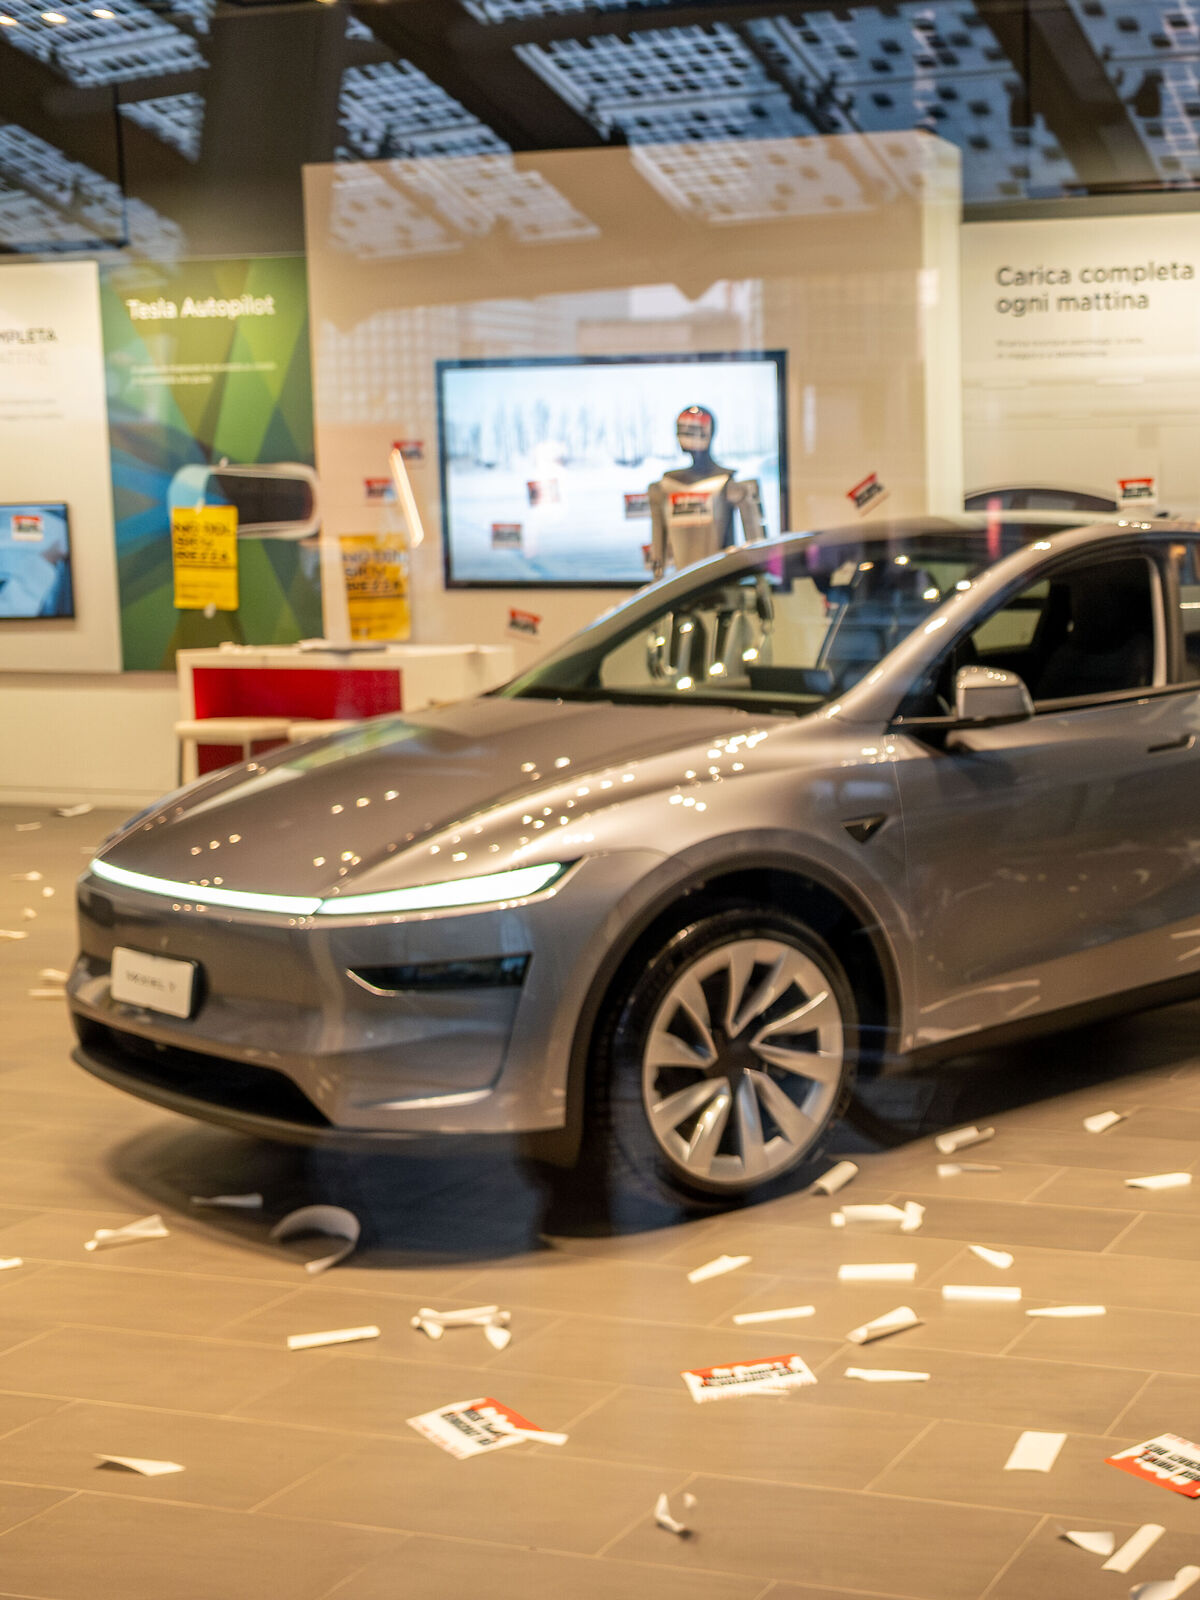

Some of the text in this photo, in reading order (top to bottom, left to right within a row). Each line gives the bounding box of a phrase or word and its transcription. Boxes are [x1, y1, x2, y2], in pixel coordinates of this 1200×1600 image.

[996, 261, 1195, 286] Carica completa
[127, 294, 275, 320] Tesla Autopilot
[996, 291, 1149, 317] ogni mattina
